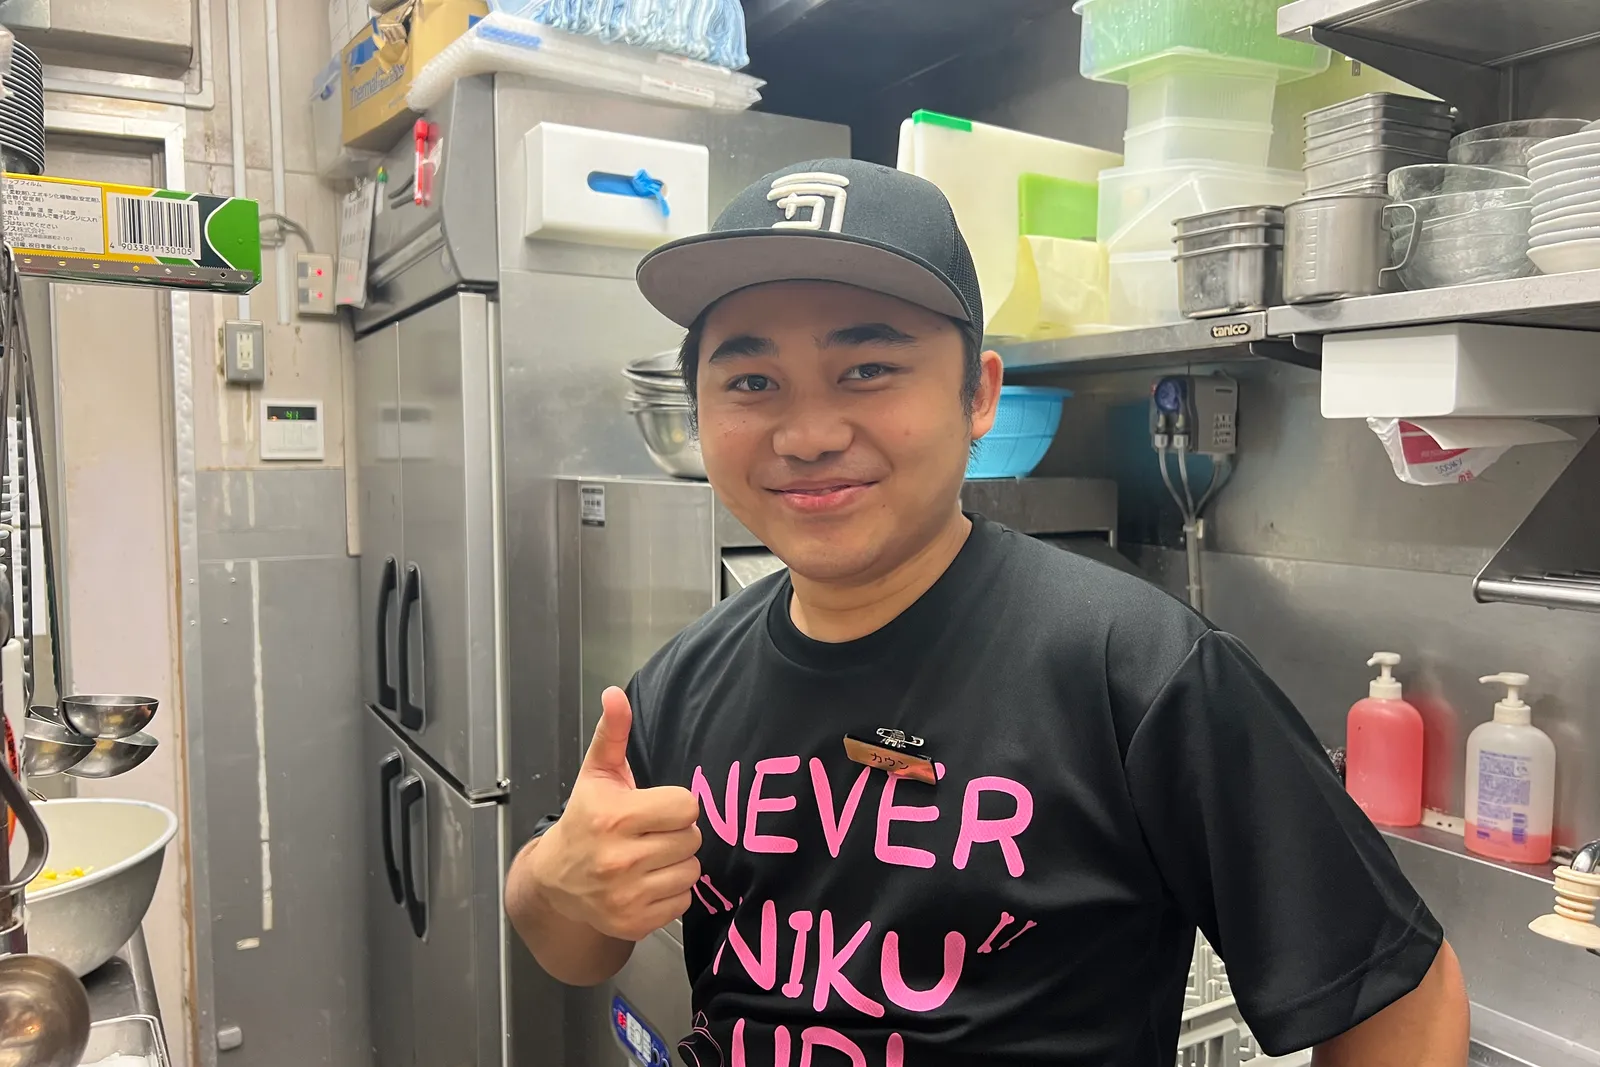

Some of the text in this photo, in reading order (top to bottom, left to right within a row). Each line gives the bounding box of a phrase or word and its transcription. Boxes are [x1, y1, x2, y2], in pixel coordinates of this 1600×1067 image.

[121, 243, 155, 252] 903381
[160, 246, 192, 255] 130105
[1213, 323, 1248, 337] tanico
[870, 752, 909, 770] カウン
[691, 755, 1034, 877] NEVER
